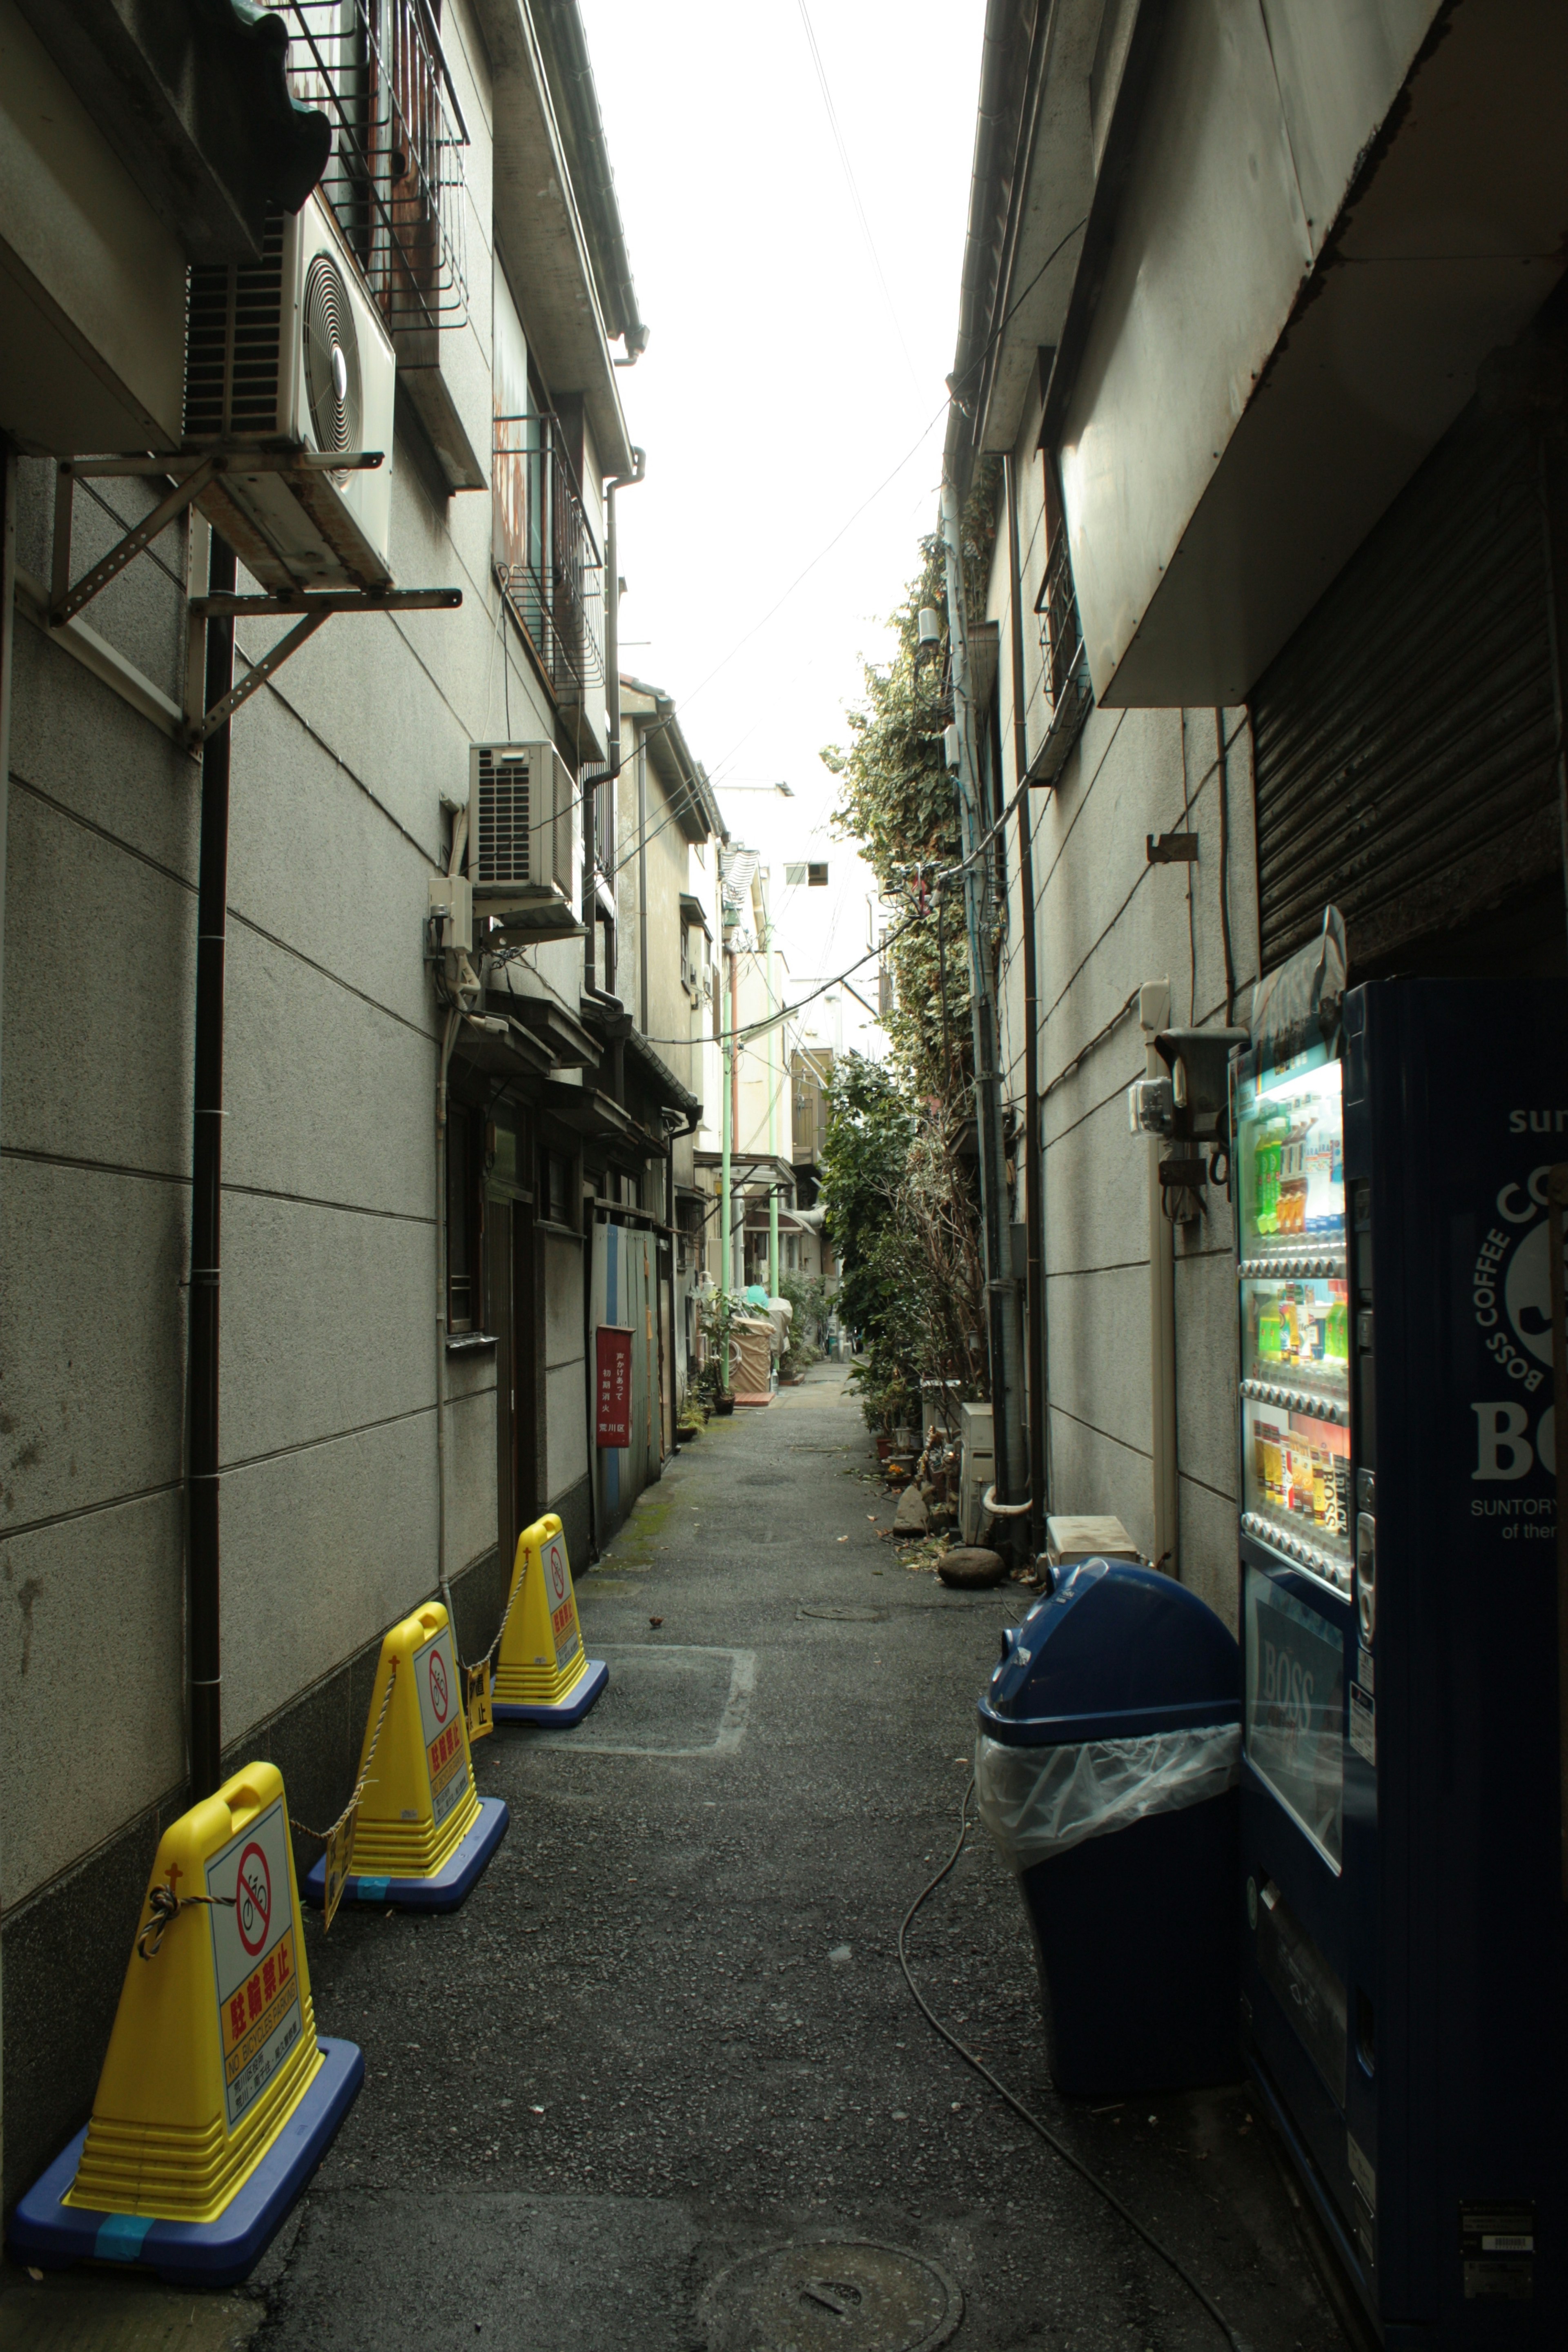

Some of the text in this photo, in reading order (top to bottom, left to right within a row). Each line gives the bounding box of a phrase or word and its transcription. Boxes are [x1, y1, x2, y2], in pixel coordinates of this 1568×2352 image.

[1473, 1228, 1545, 1392] BOSS COFFEE
[602, 1369, 611, 1413] 初期消火
[616, 1353, 624, 1401] 声かけあって
[599, 1423, 625, 1432] 荒川区
[1502, 1523, 1519, 1539] of
[1264, 1640, 1313, 1735] BOSS
[431, 1721, 460, 1772] 駐輪禁止
[230, 1942, 290, 2040] 駐輪禁止
[228, 1983, 296, 2078] NO BICYCLES PARKING
